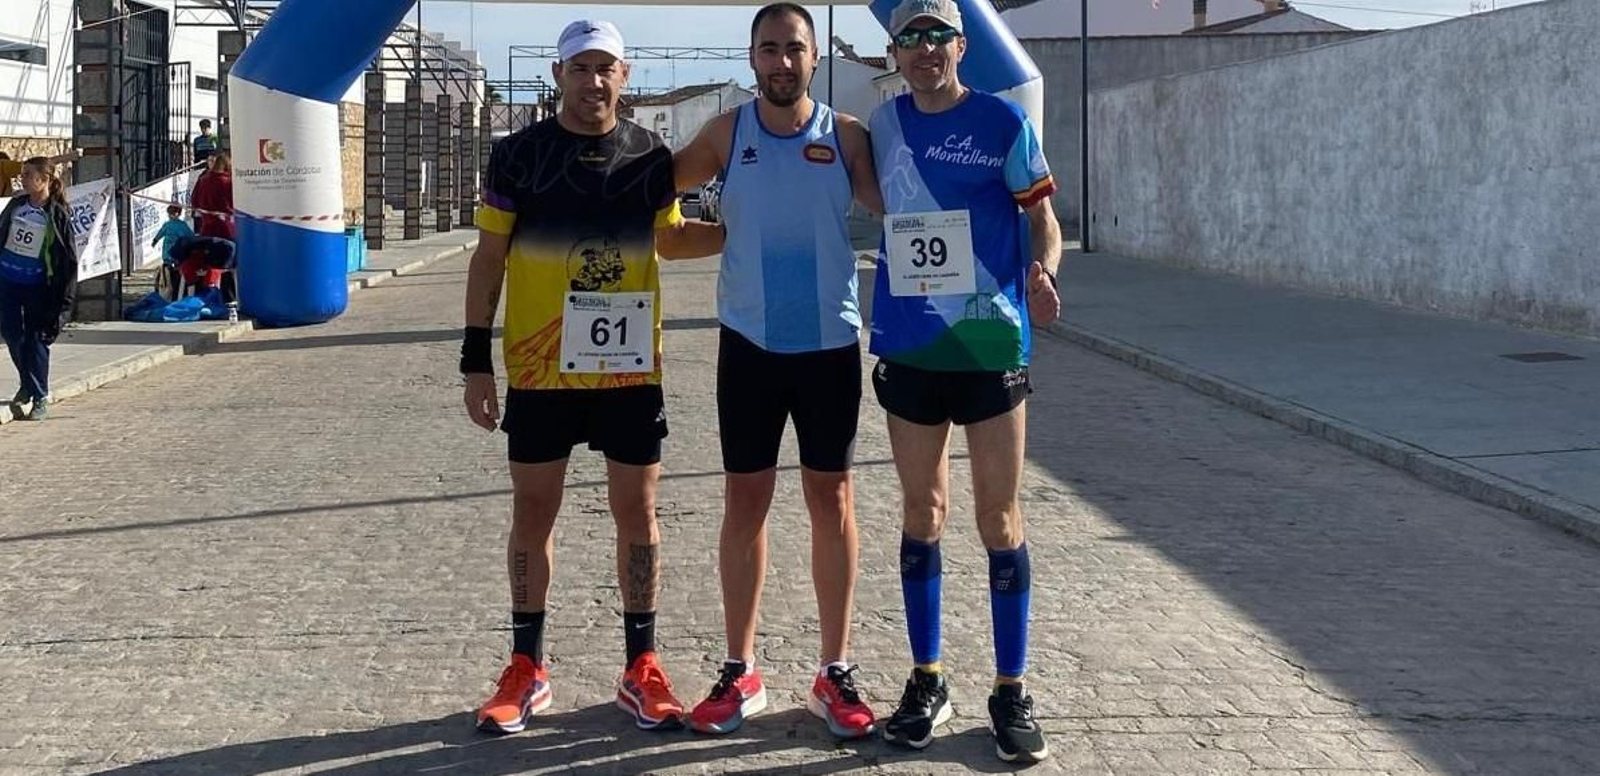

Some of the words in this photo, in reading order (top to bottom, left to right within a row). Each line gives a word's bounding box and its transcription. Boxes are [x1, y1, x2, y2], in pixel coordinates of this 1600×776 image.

[944, 134, 973, 151] C.A.
[925, 144, 1004, 168] Montellano
[15, 228, 34, 245] 56
[910, 236, 948, 268] 39
[590, 316, 628, 347] 61
